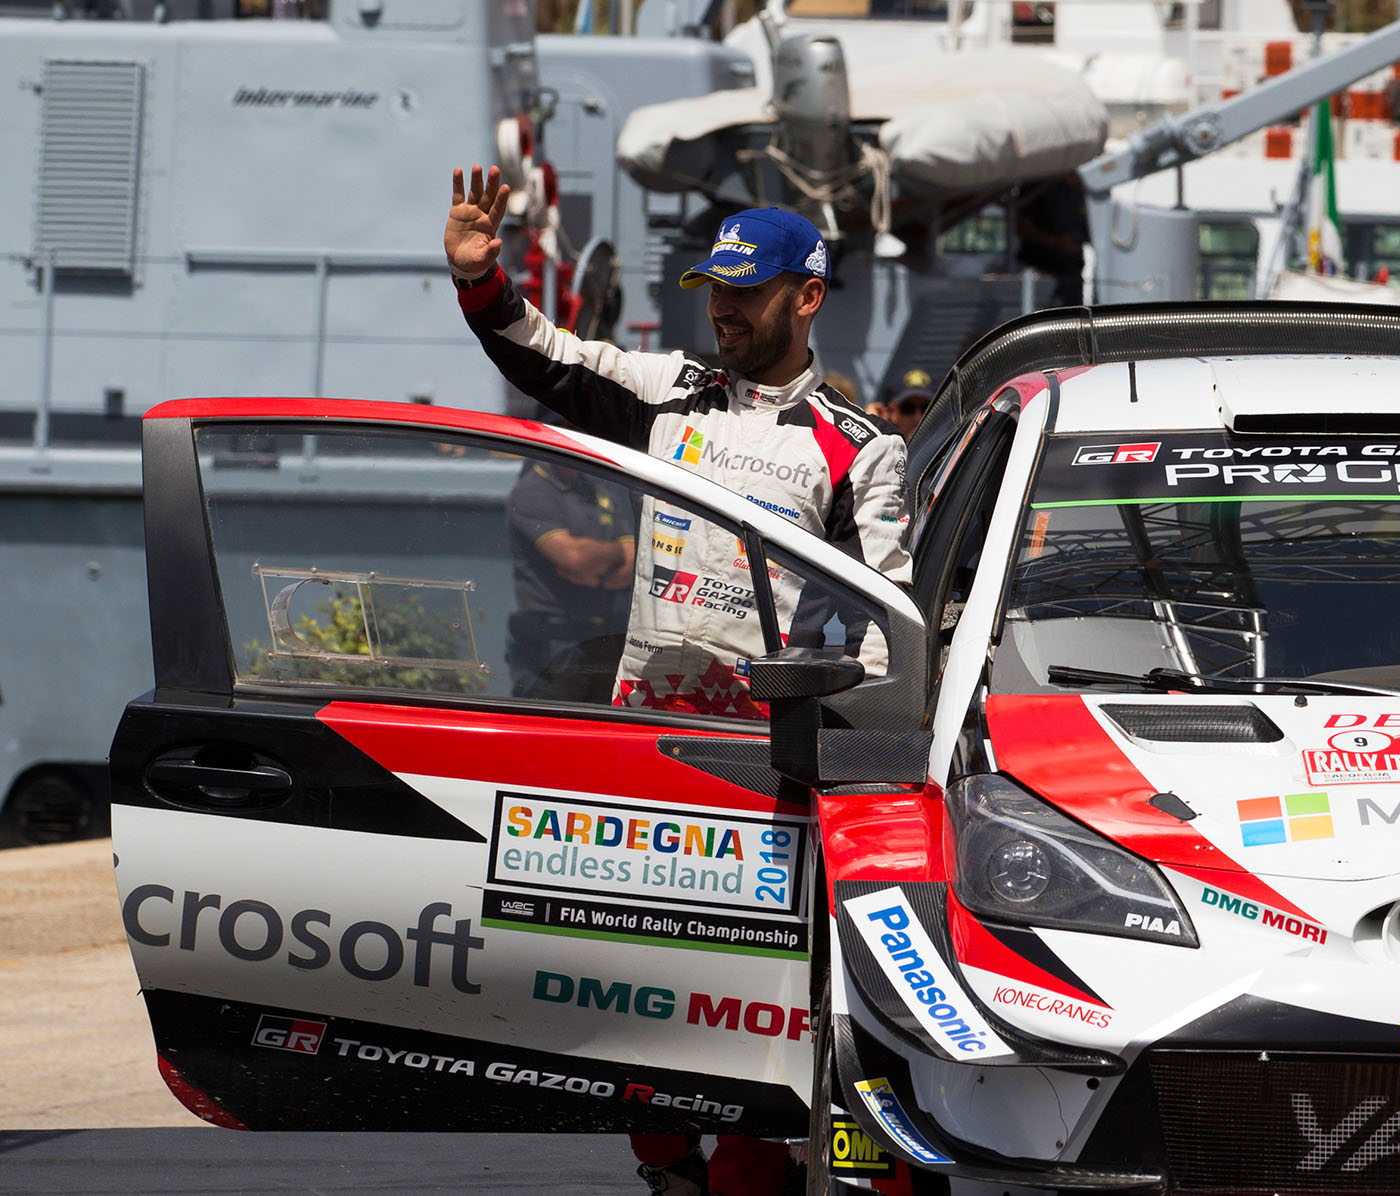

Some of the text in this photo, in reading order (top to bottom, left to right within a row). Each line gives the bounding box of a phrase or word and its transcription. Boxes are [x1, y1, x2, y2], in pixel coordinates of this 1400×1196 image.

[840, 419, 870, 441] OMP
[702, 439, 813, 489] Microsoft
[1077, 449, 1154, 463] GR
[1172, 446, 1348, 460] TOYOTA
[650, 575, 690, 603] GR
[690, 596, 748, 620] Racing
[702, 577, 755, 598] TOYOT
[1314, 751, 1378, 772] RALLY
[1353, 736, 1369, 748] 9
[506, 806, 744, 861] SARDEGNA
[503, 846, 744, 895] endless island
[755, 828, 792, 904] 2018
[113, 853, 485, 995] crosoft
[560, 906, 799, 948] FIA World Rally Championship
[1124, 912, 1182, 937] PIAA
[1200, 887, 1328, 945] DMG MORI
[867, 904, 987, 1054] Panasonic
[532, 969, 814, 1044] DMG MOR
[992, 986, 1116, 1030] KONECRANES
[256, 1028, 745, 1123] GR TOYOTA GAZOO Racing
[883, 1111, 939, 1160] MICHELIN
